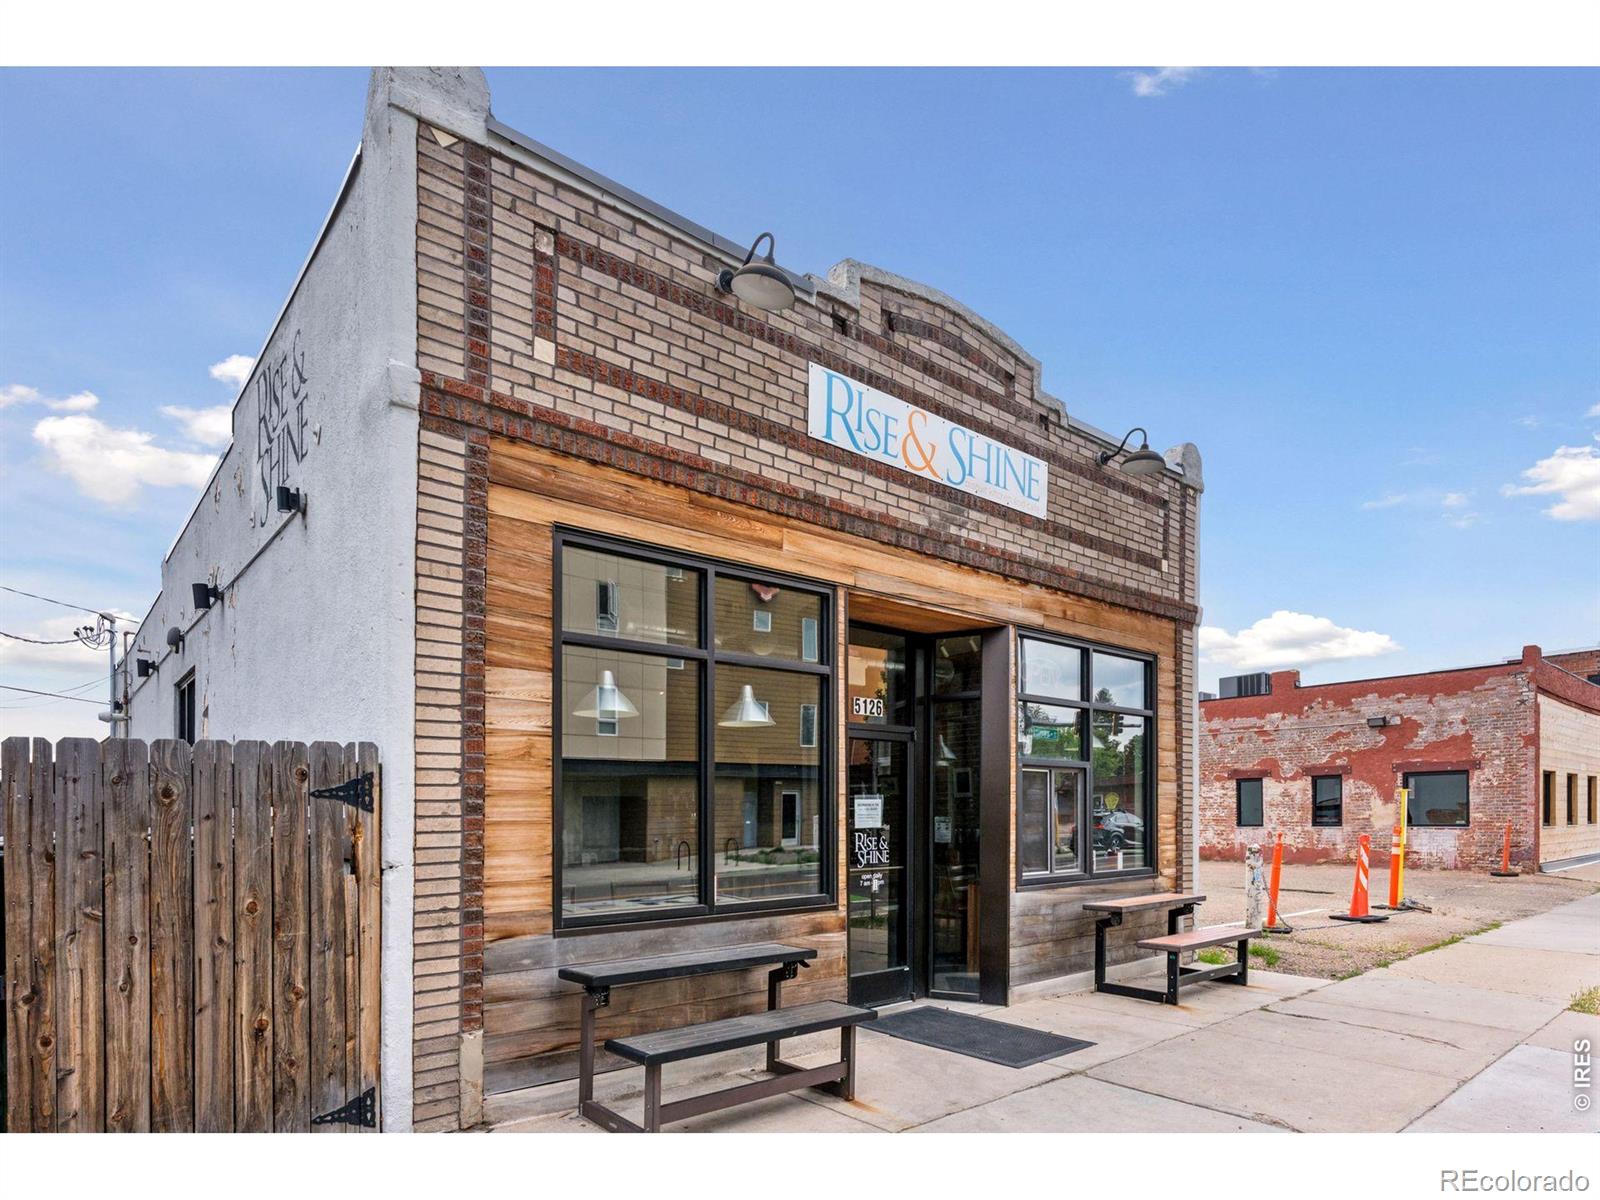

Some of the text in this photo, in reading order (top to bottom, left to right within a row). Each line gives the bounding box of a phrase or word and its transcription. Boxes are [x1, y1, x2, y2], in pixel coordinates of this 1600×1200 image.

[256, 328, 308, 464] RISE &
[259, 391, 309, 528] SHINE
[822, 370, 1040, 502] RISE & SHINE
[854, 697, 882, 716] 5126
[854, 832, 889, 853] RISE &
[857, 850, 890, 868] SHINE
